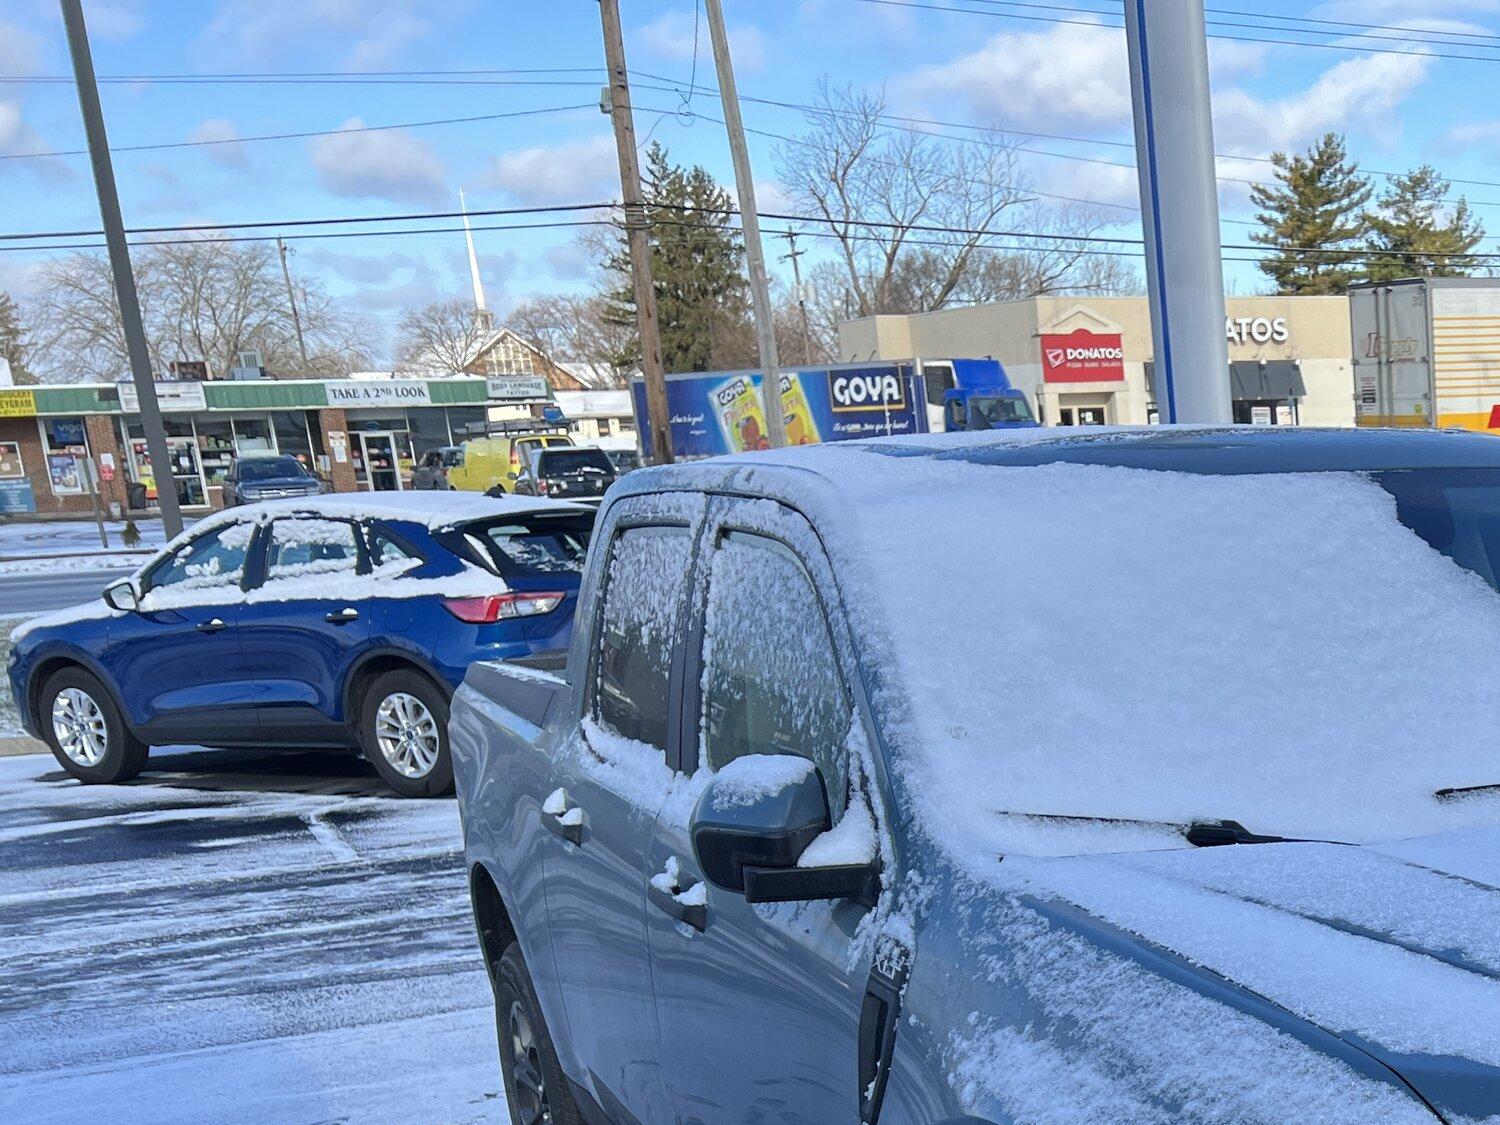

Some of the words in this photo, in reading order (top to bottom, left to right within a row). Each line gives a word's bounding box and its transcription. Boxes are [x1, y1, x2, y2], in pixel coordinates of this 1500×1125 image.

[1225, 317, 1289, 342] ATOS
[1066, 347, 1123, 360] DONATOS
[331, 387, 360, 399] TAKE
[363, 388, 371, 398] A
[374, 387, 392, 398] 2ND
[395, 387, 426, 398] LOOK
[491, 382, 508, 391] BODY
[509, 382, 542, 391] LANGUAGE
[833, 375, 900, 405] GOYA
